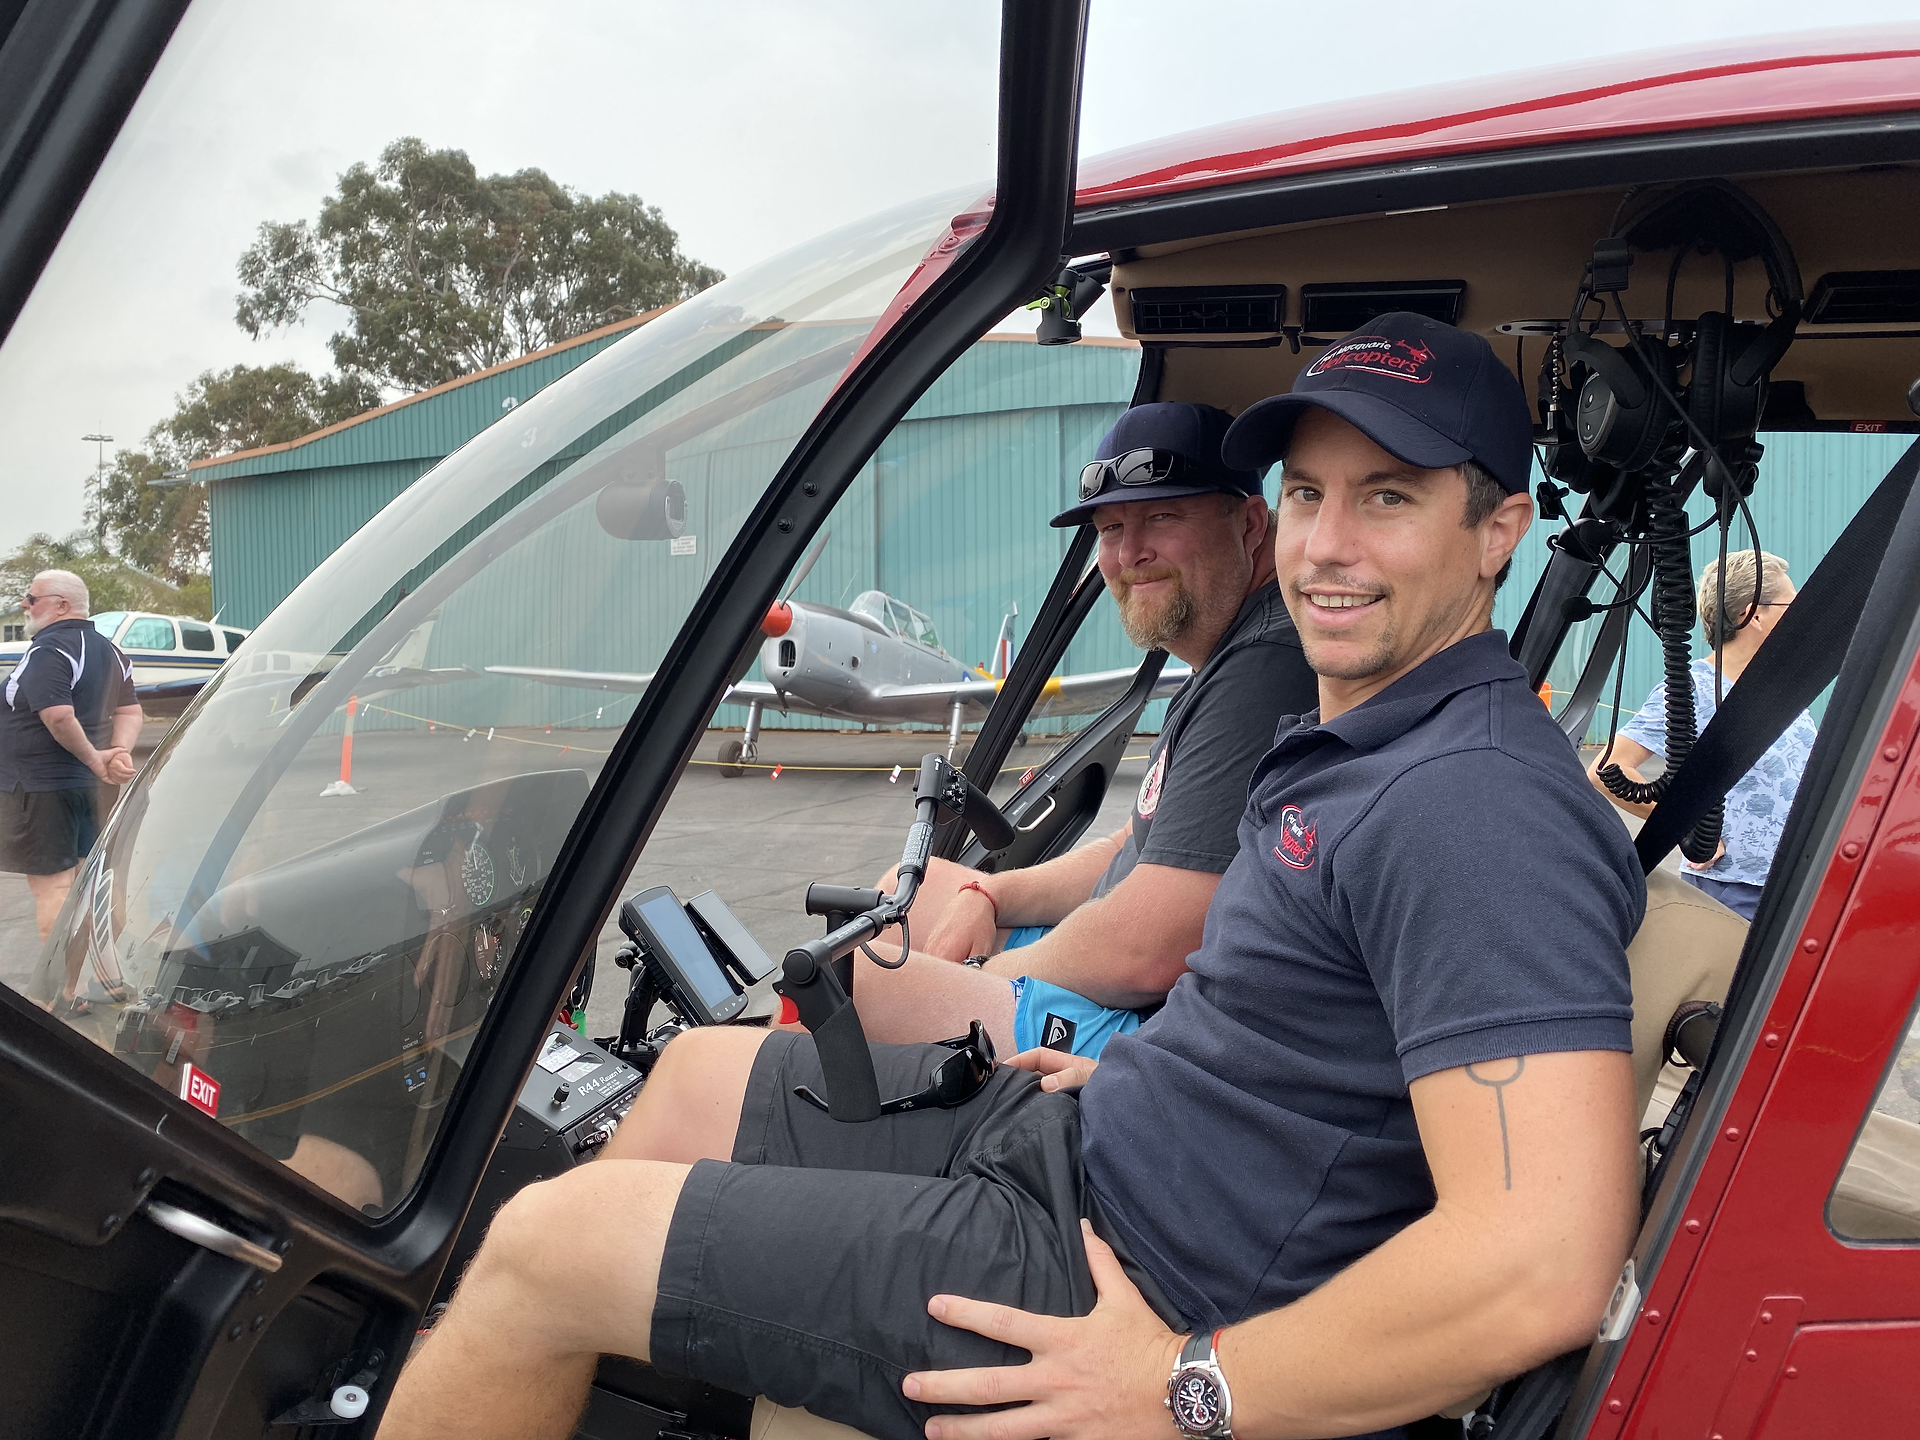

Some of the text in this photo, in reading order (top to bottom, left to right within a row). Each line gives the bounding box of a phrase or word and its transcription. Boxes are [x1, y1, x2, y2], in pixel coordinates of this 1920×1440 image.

[1855, 423, 1883, 433] EXIT
[1021, 771, 1034, 784] EXIT
[190, 1075, 217, 1108] EXIT
[577, 1078, 601, 1097] R44
